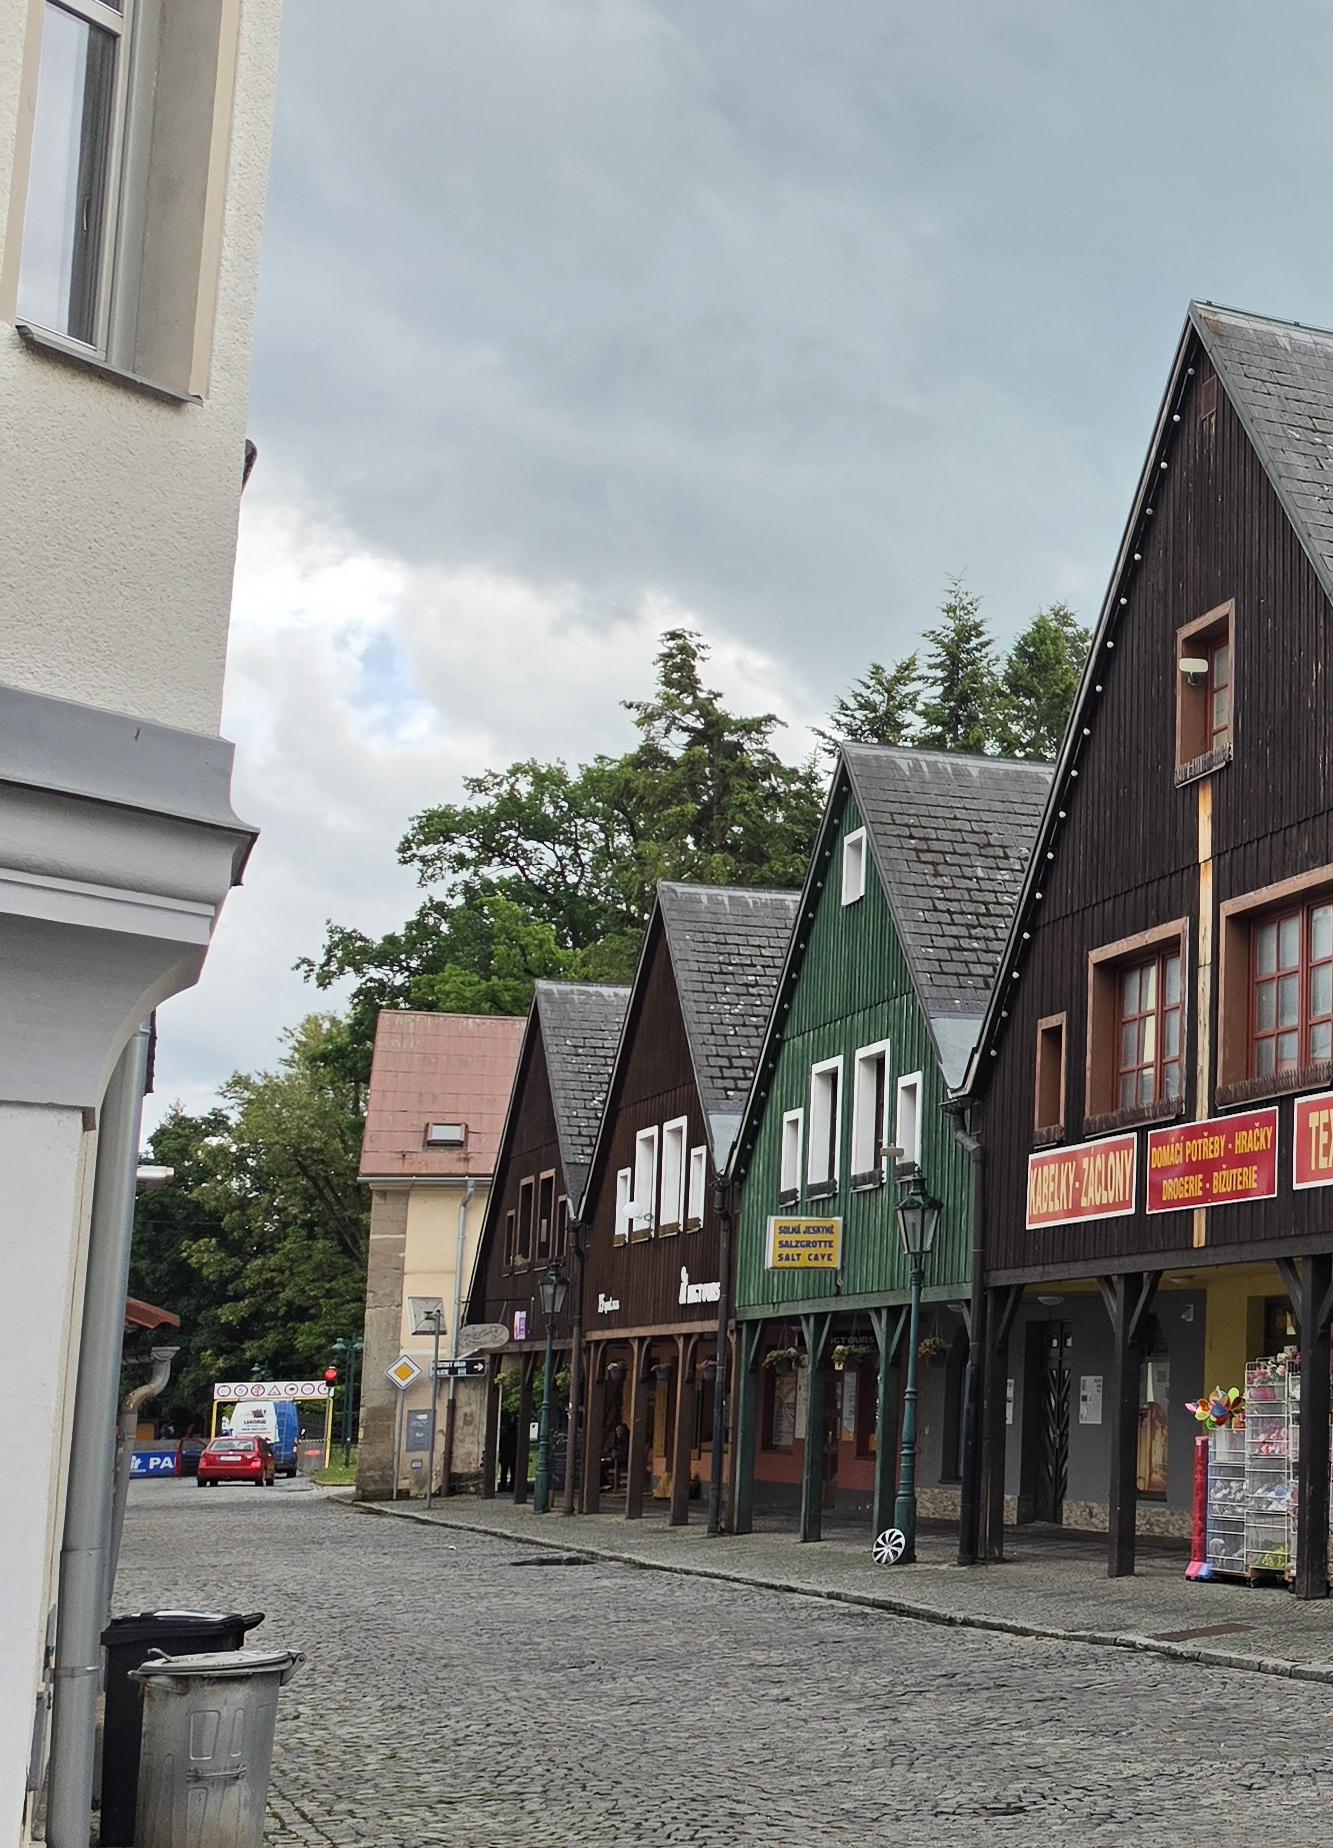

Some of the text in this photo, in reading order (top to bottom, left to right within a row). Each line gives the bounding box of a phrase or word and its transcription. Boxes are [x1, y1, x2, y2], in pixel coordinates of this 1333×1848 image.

[1151, 1136, 1184, 1168] DOMÁCÍ
[1186, 1133, 1225, 1162] POTŘEBY
[1235, 1122, 1273, 1154] HRAČKY
[1030, 1161, 1076, 1215] KABELKY
[1081, 1148, 1133, 1207] ZÁCLONY
[1162, 1174, 1202, 1201] DROGERIE
[1212, 1165, 1257, 1194] BIŽUTERIE
[778, 1224, 835, 1235] SOLNÁ JESKYNĚ
[778, 1240, 834, 1249] SALZGROTTE
[778, 1253, 833, 1262] SALT CAVE
